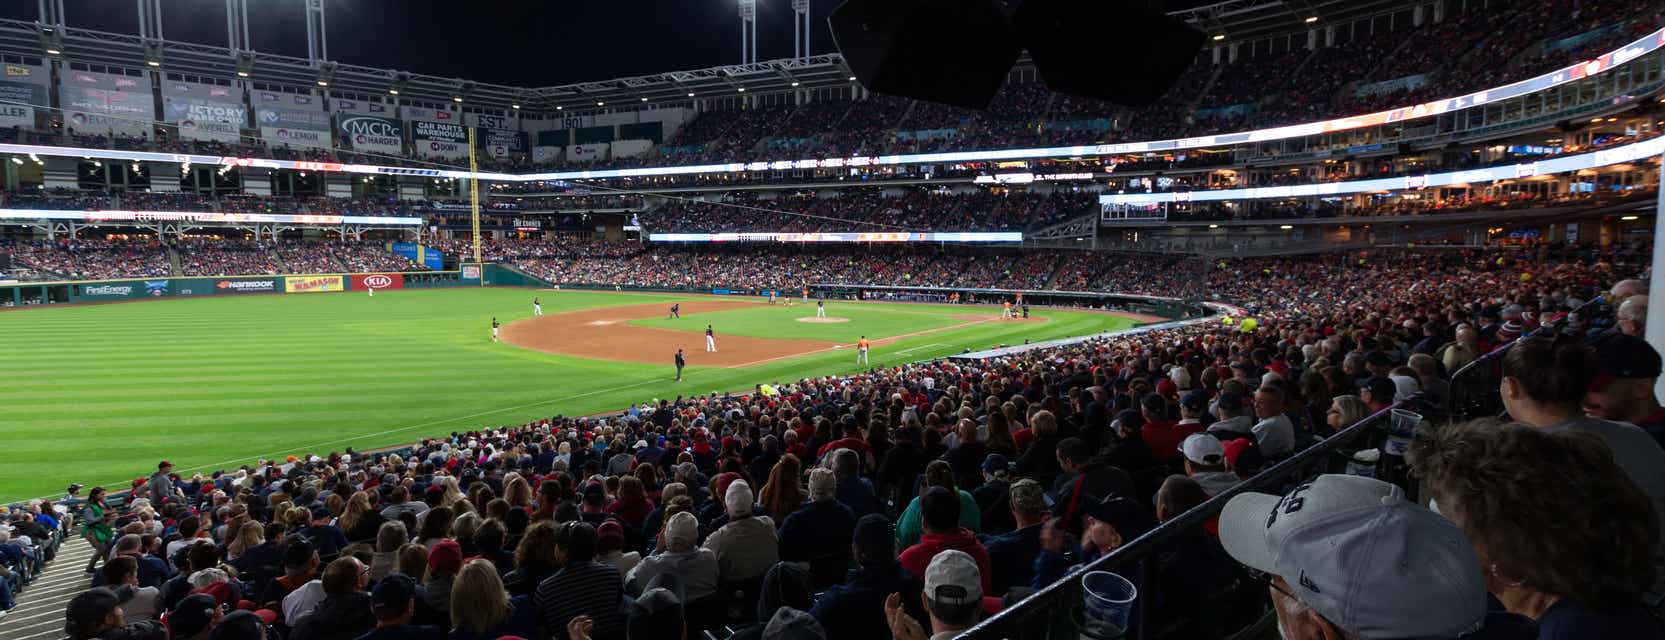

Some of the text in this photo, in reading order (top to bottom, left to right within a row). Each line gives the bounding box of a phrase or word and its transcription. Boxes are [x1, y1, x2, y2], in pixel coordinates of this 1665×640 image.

[479, 115, 508, 128] EST.
[561, 118, 582, 128] 1901
[416, 128, 466, 138] WAREHOUSE
[437, 124, 463, 132] PARTS
[368, 137, 399, 146] HARDER
